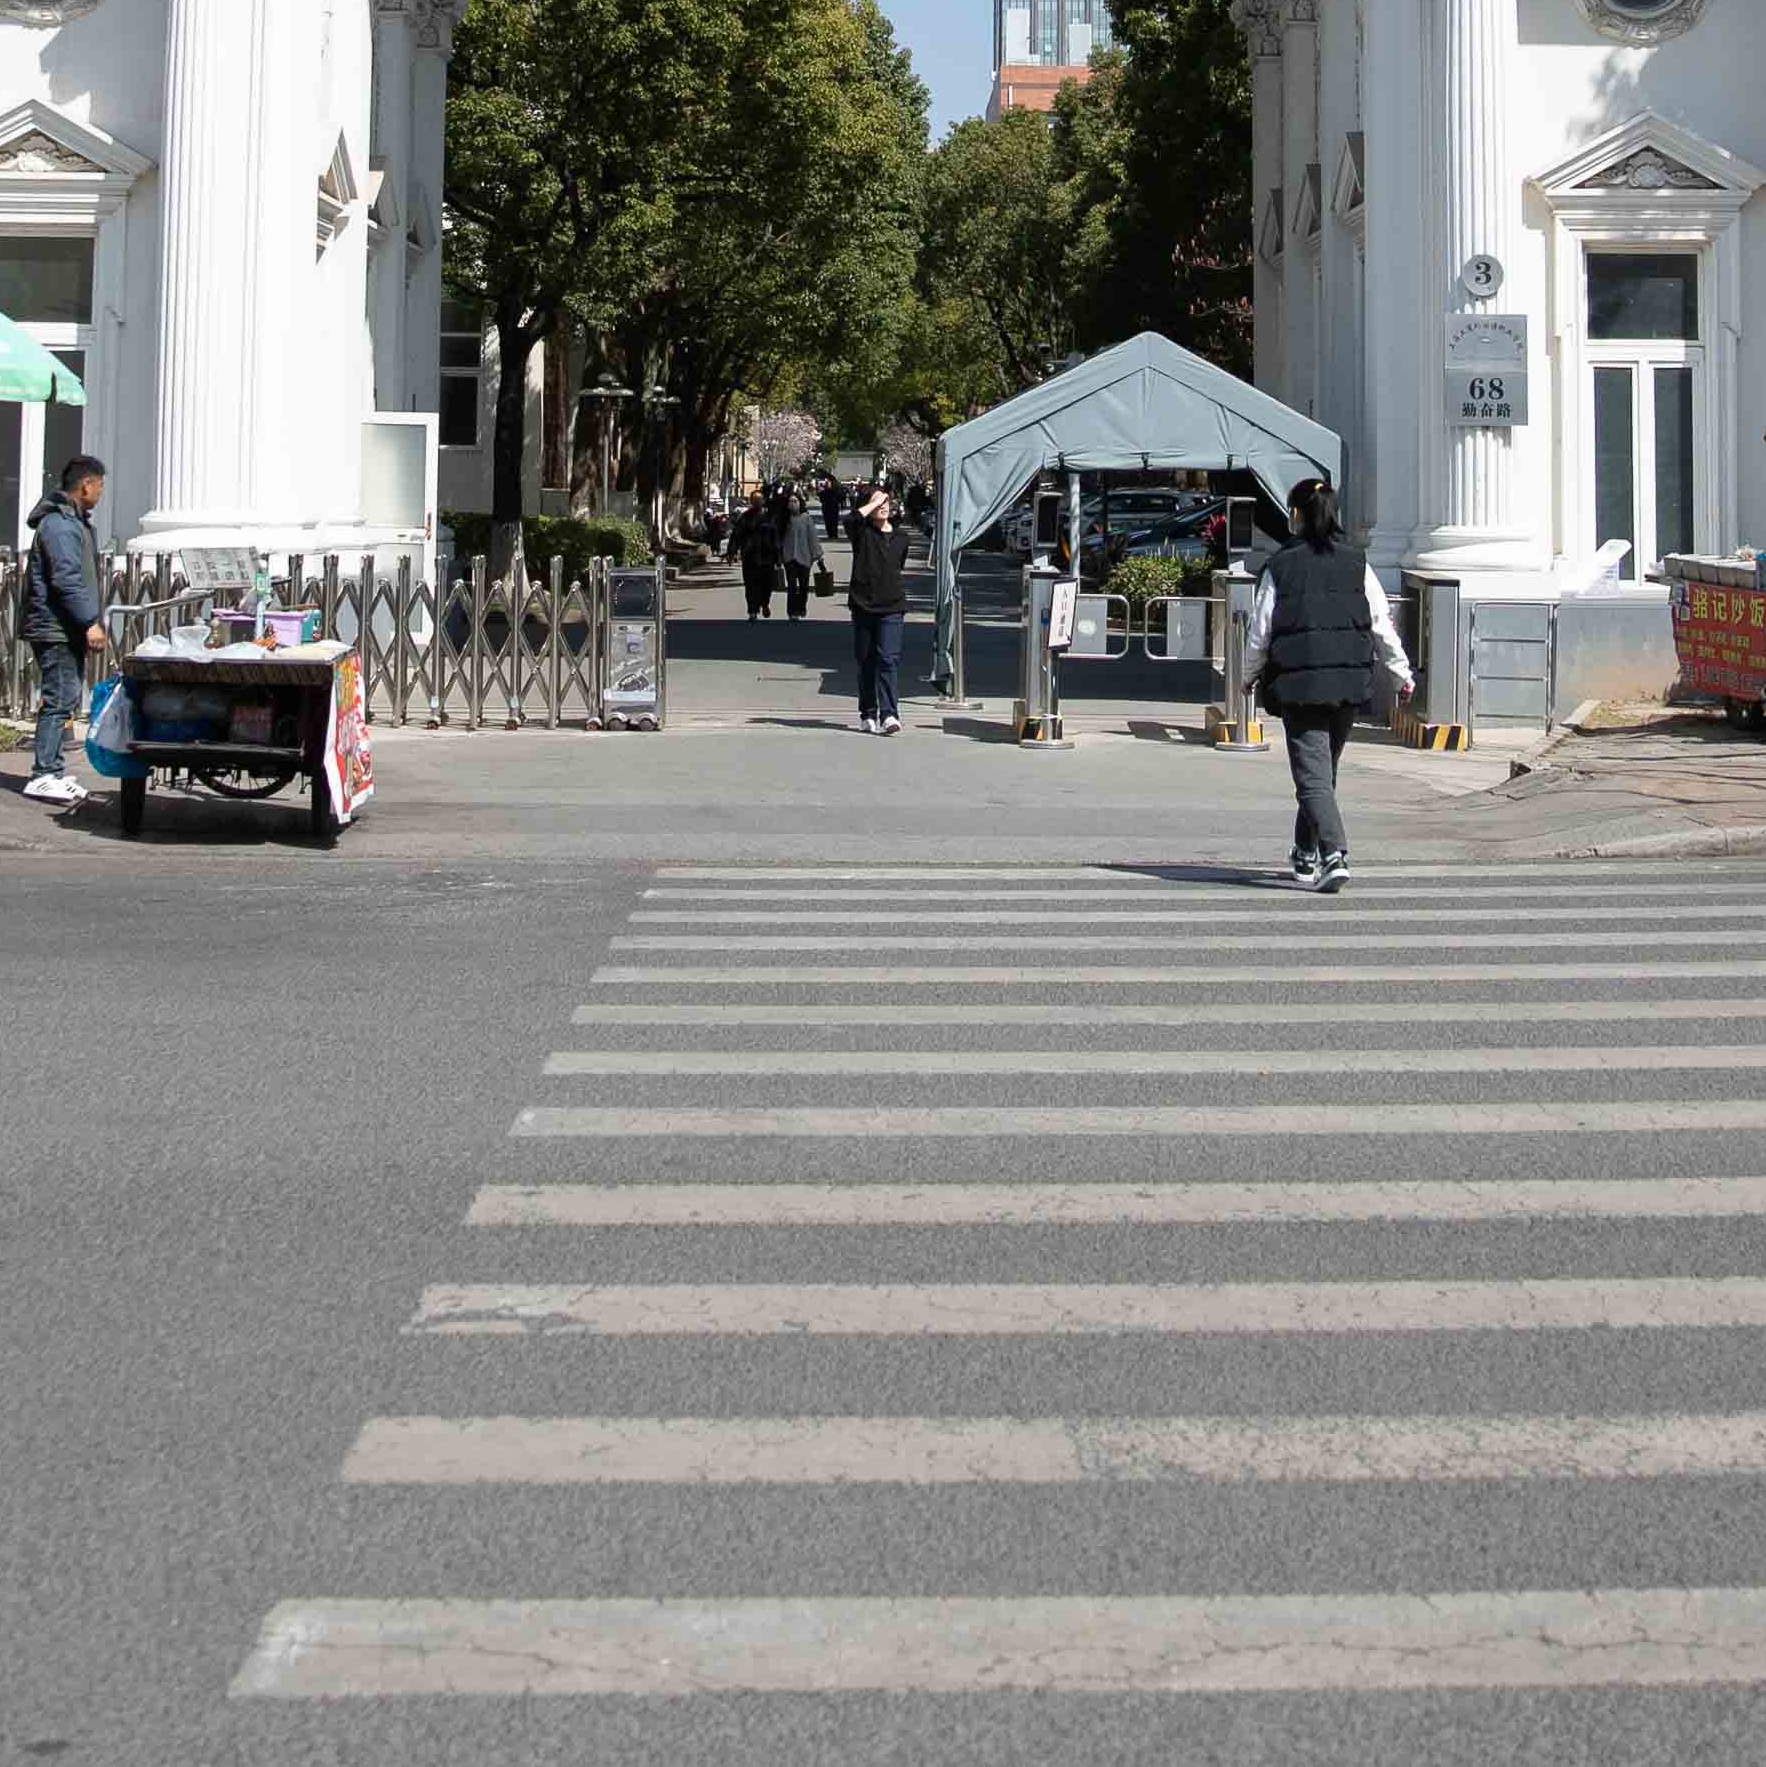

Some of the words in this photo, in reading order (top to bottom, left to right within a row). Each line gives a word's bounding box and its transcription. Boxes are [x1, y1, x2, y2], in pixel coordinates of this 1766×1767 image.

[1475, 261, 1492, 284] 3
[1469, 377, 1504, 400] 68
[1462, 402, 1511, 419] 勤奋路
